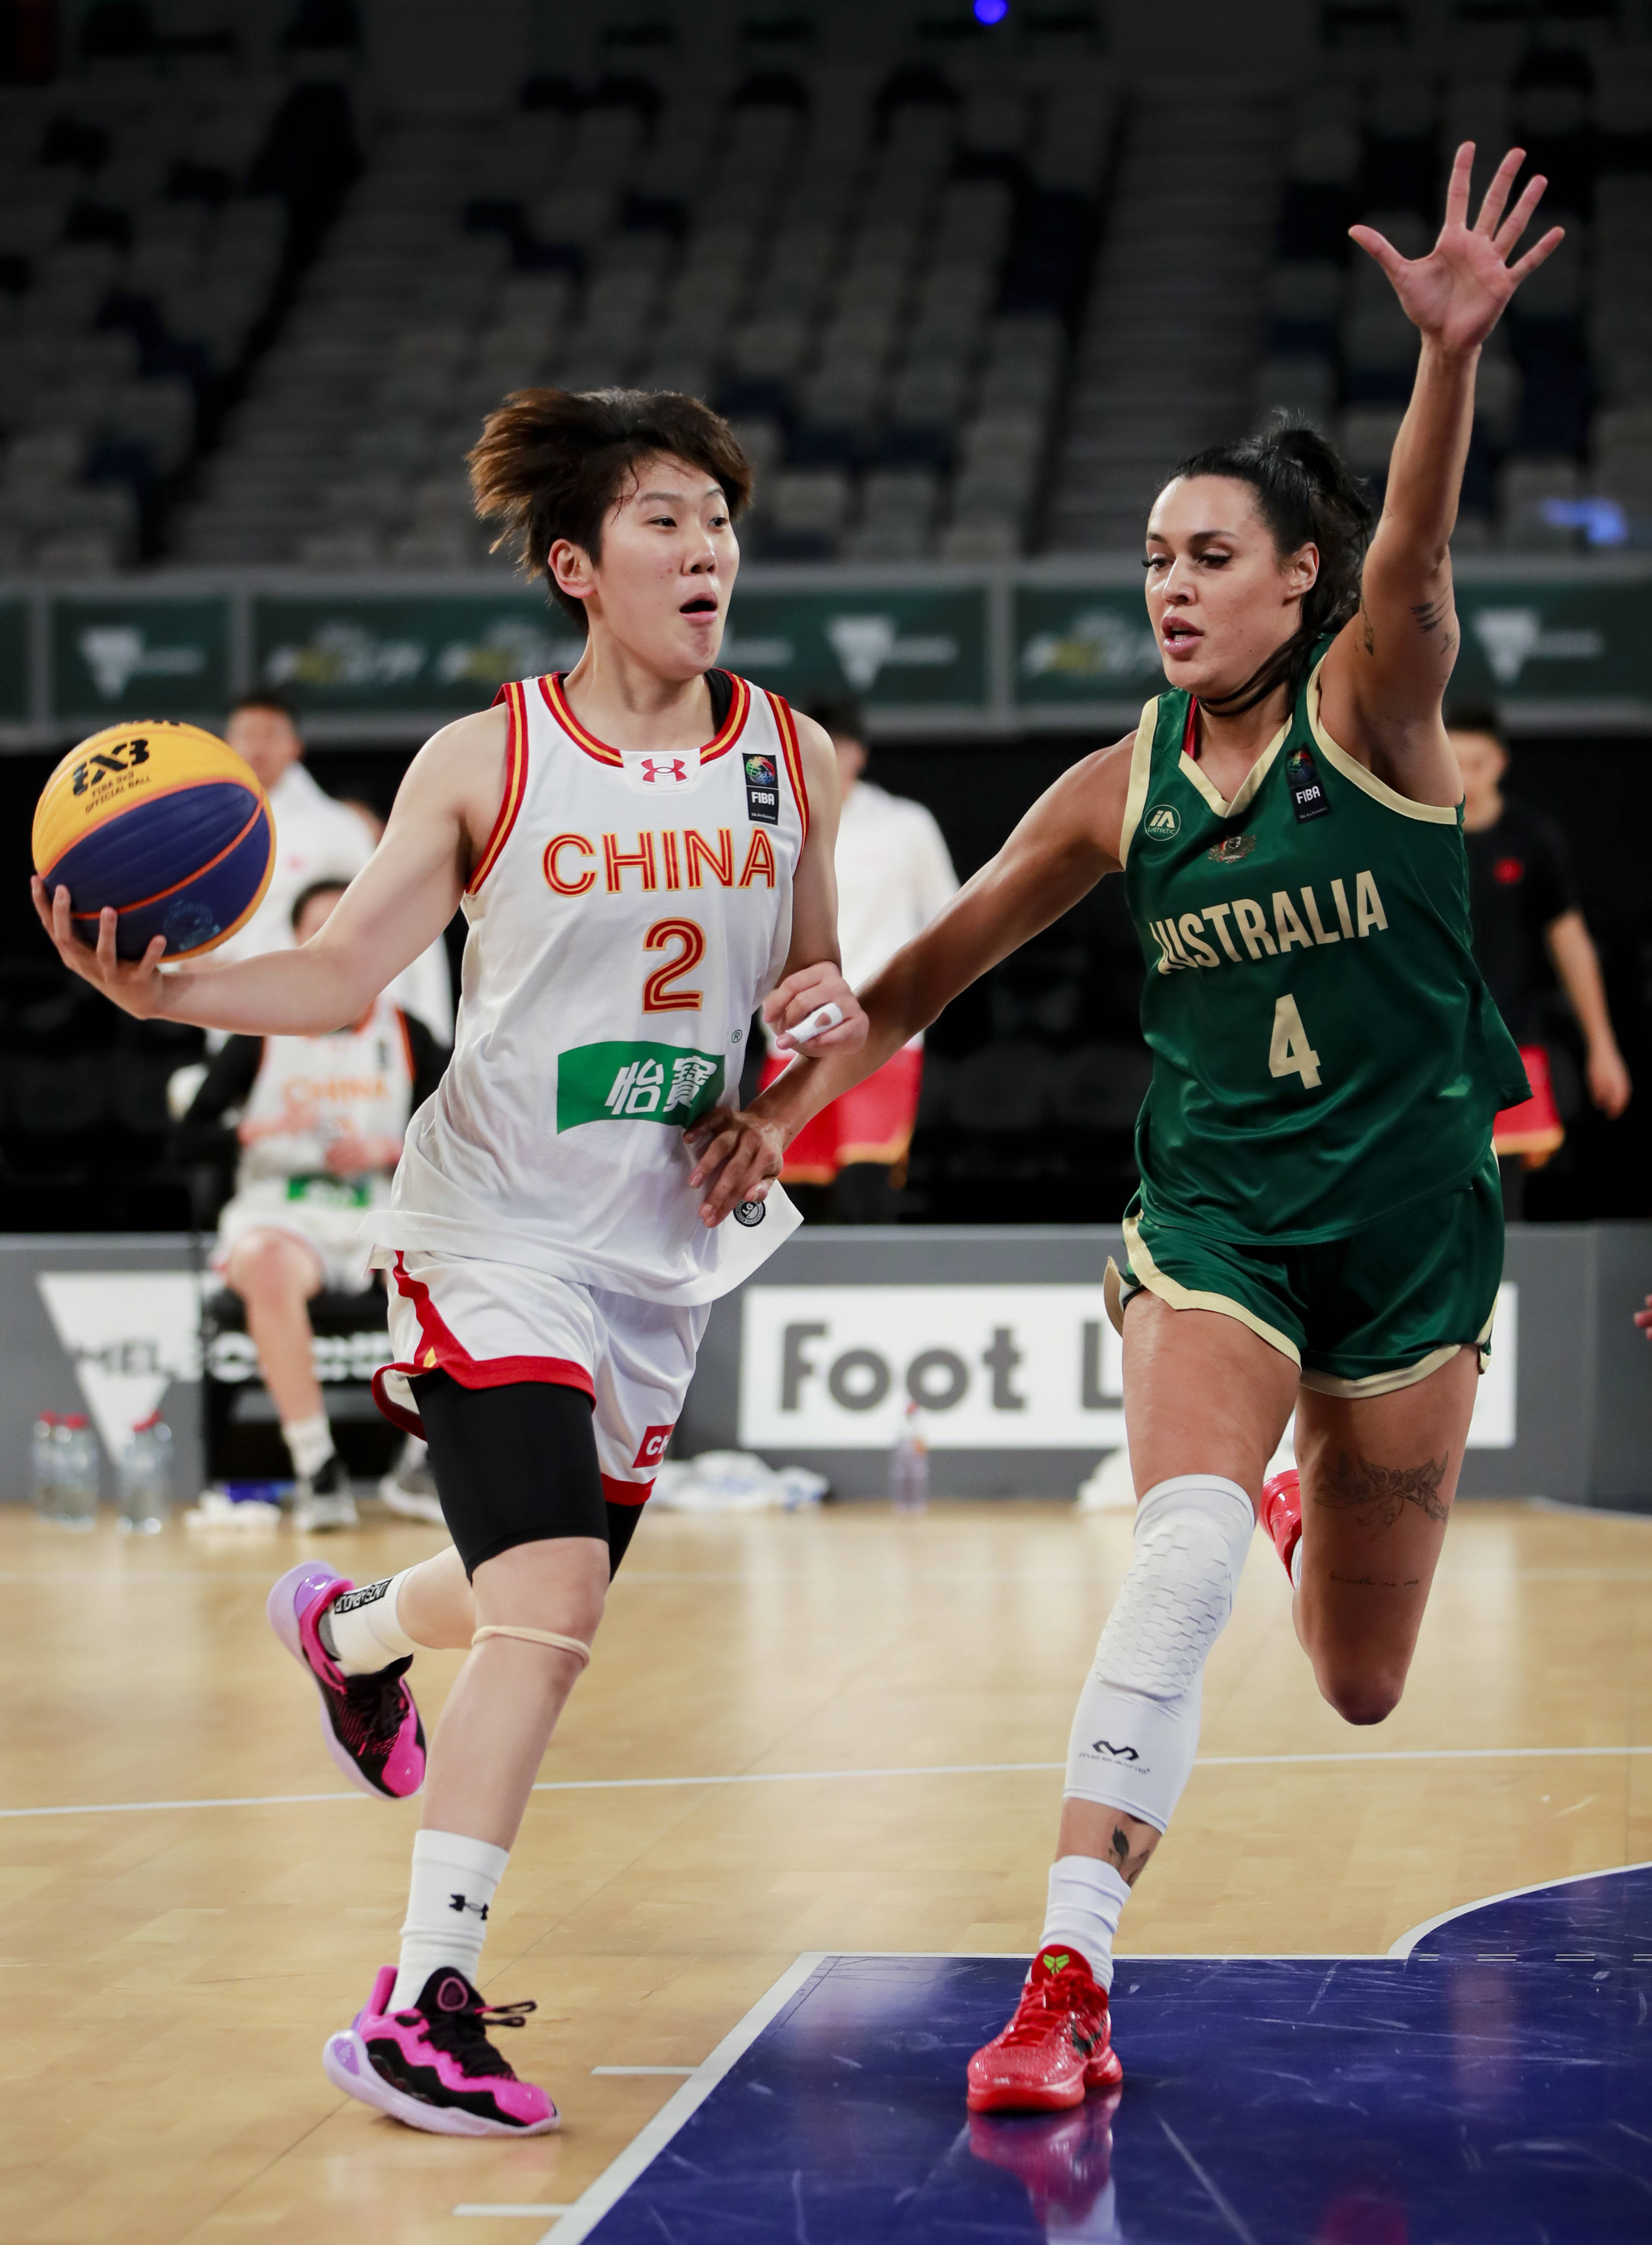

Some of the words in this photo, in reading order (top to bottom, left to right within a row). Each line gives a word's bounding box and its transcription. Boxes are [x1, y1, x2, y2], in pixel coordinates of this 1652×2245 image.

[751, 791, 775, 806] FIBA
[1295, 786, 1320, 804] FIBA
[542, 827, 776, 898] CHINA
[1148, 870, 1389, 975] USTRALIA
[642, 916, 707, 1015] 2
[1268, 993, 1322, 1090] 4
[604, 1055, 718, 1115] 怡寶
[781, 1322, 1025, 1410] Foot
